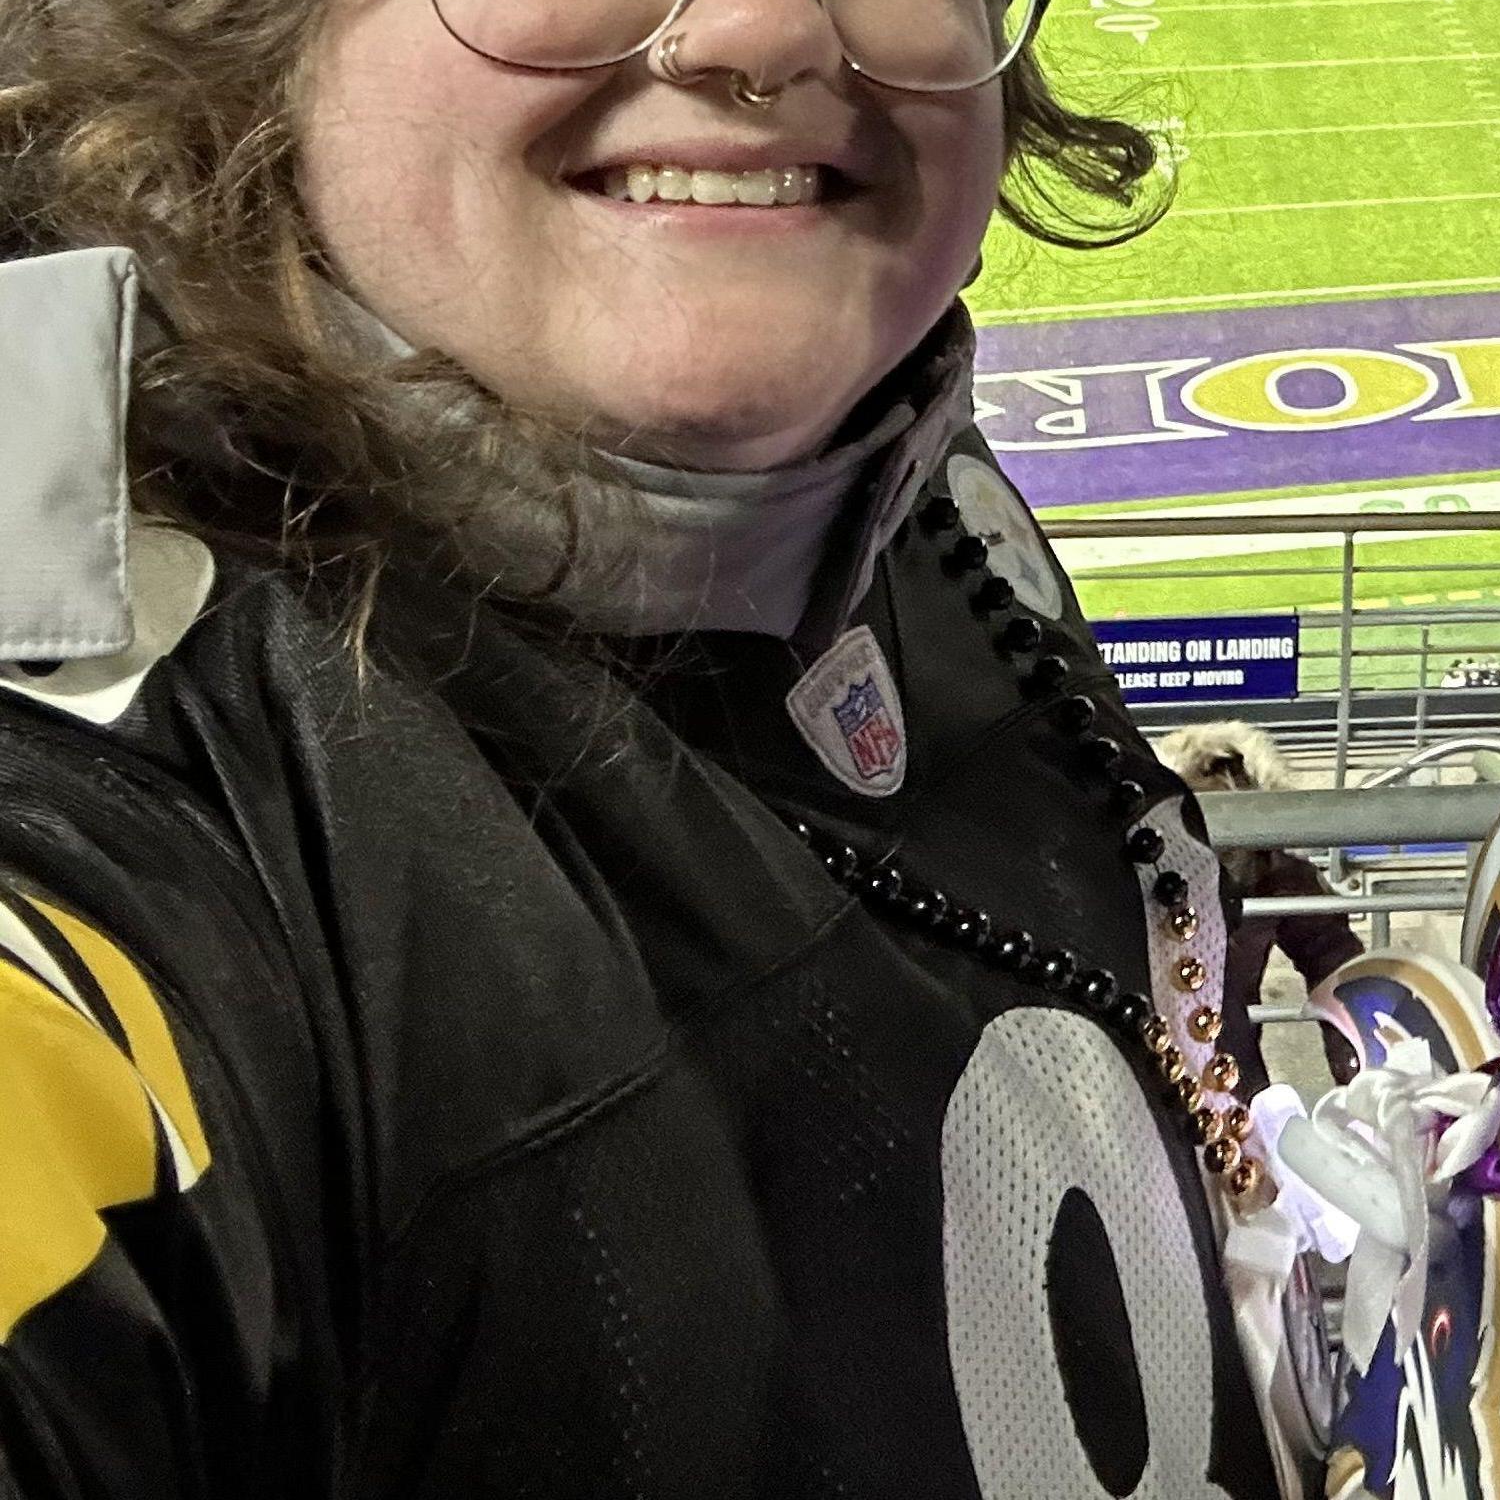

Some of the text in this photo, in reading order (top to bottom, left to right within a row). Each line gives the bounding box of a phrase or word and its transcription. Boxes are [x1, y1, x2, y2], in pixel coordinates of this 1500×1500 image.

[1097, 637, 1295, 665] TANDING ON LANDING
[1114, 670, 1245, 689] LEASE KEEP MOVING
